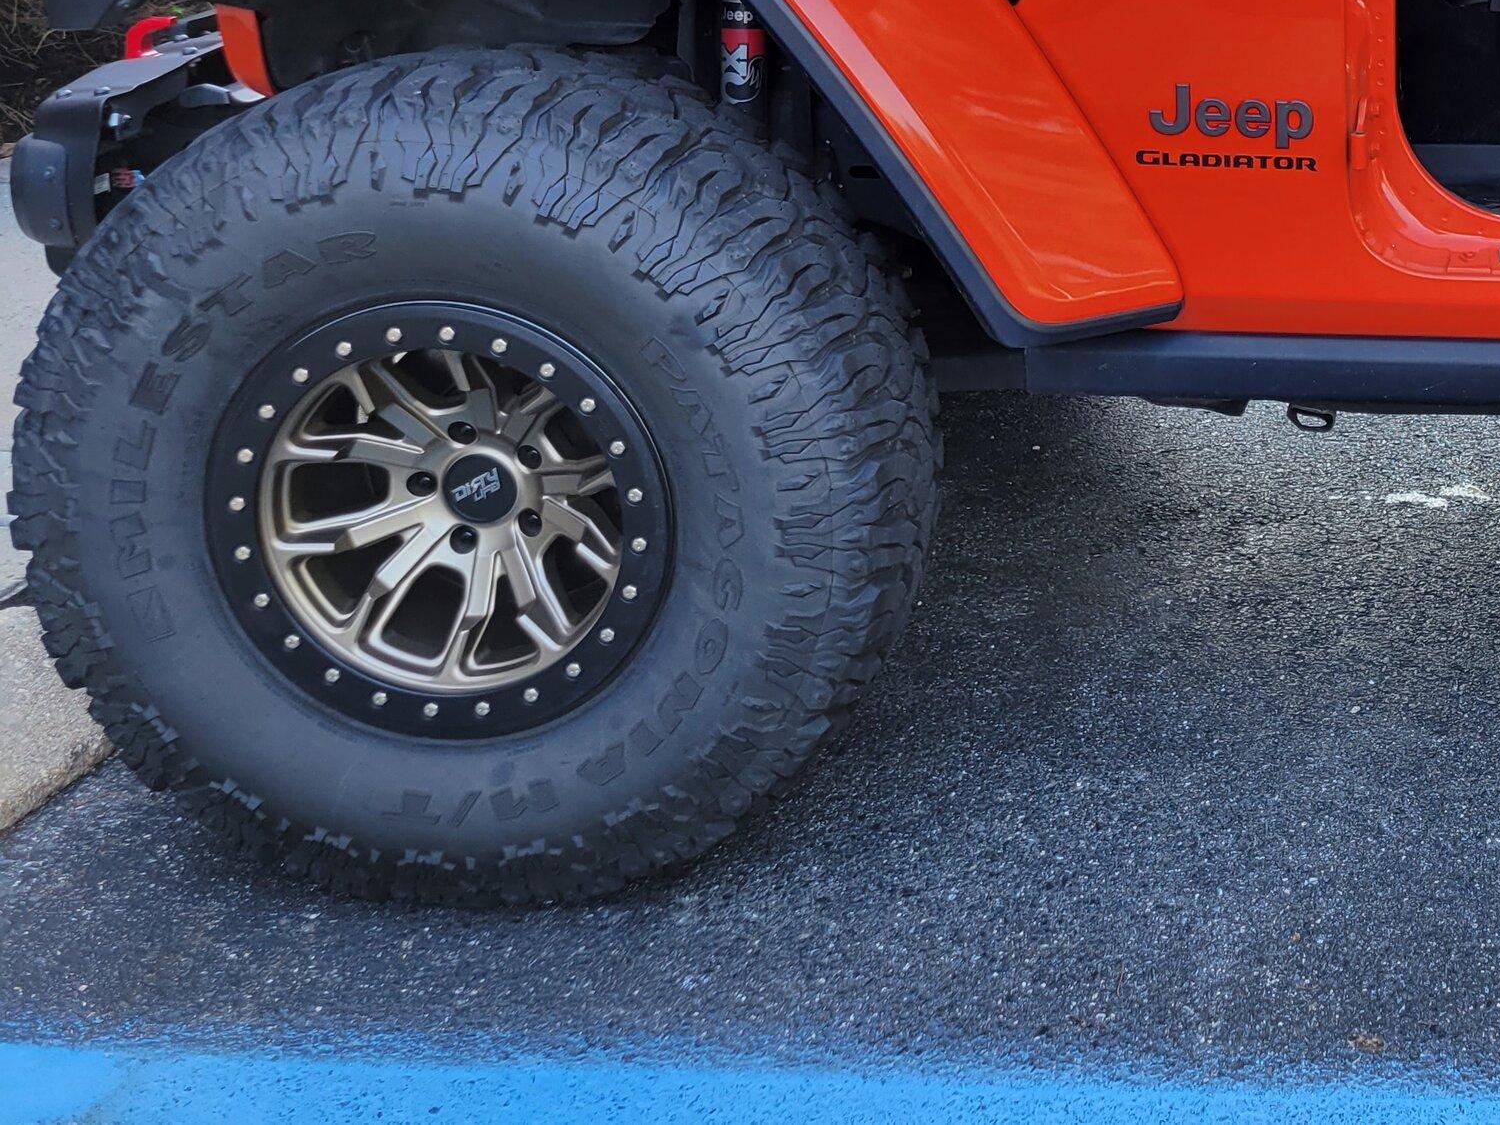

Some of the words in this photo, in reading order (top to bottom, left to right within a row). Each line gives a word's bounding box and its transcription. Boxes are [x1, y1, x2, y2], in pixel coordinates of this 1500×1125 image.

[722, 6, 754, 24] Jeep
[1148, 83, 1314, 149] Jeep
[1135, 149, 1318, 172] GLADIATOR
